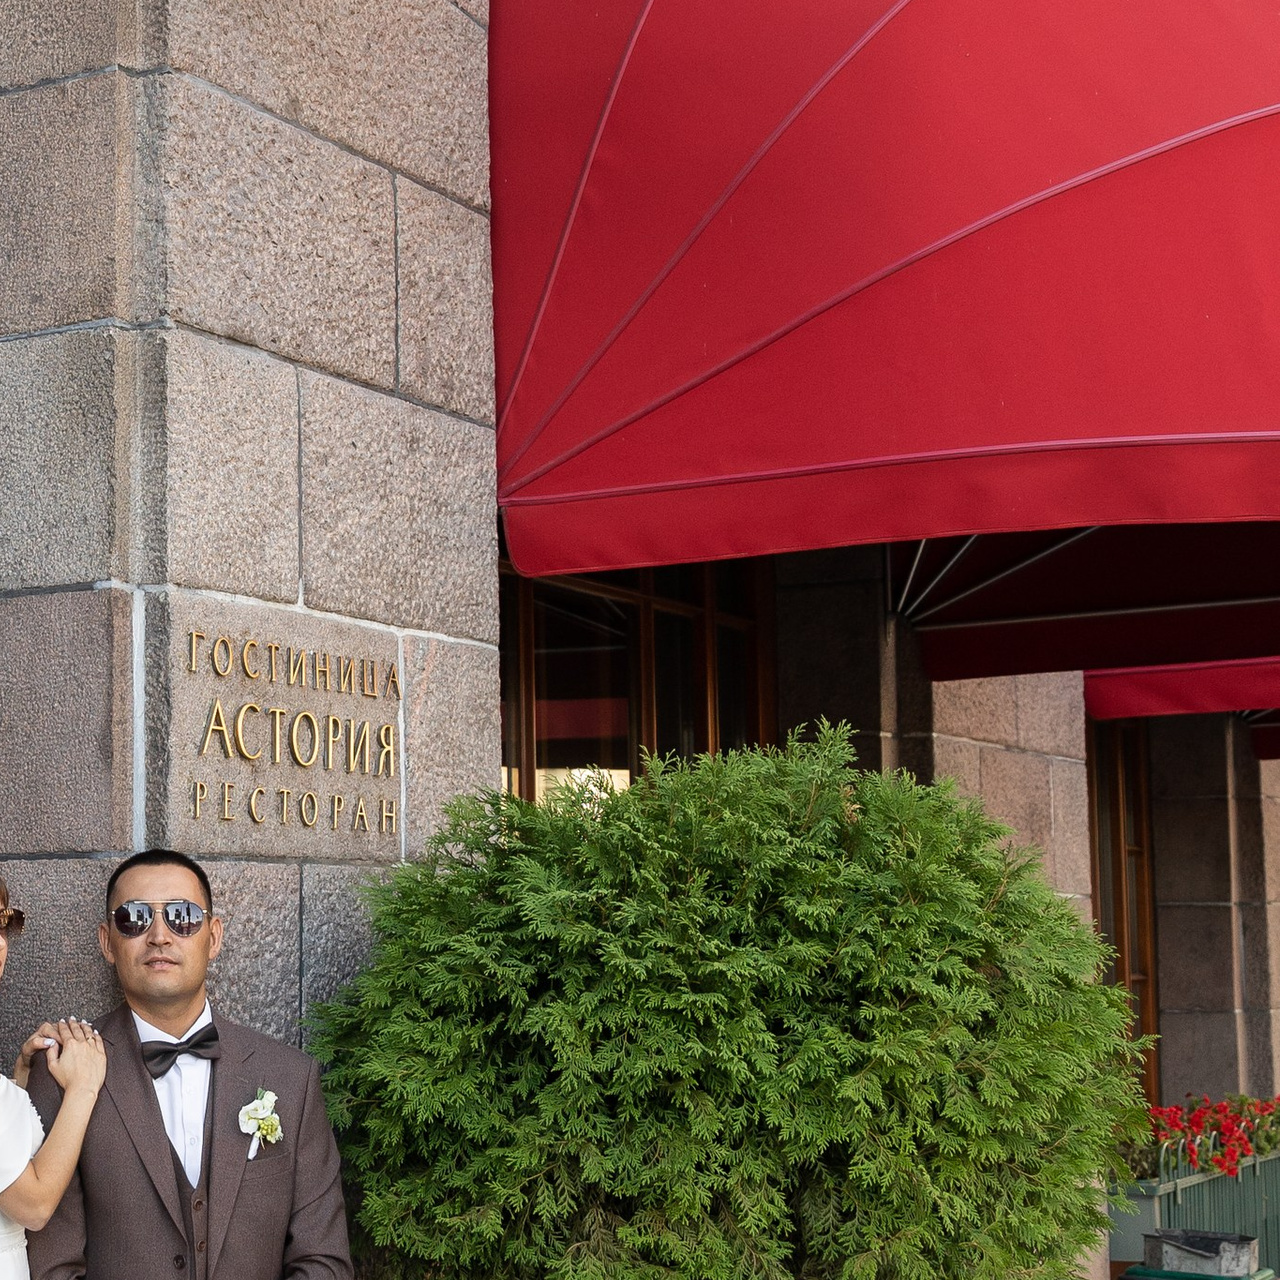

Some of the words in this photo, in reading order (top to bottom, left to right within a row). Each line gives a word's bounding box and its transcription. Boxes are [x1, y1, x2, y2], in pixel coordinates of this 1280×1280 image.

[189, 631, 402, 700] ГОСТИНИЦА
[202, 699, 396, 777] АСТОРИЯ
[194, 781, 397, 833] РЕСТОРАН
